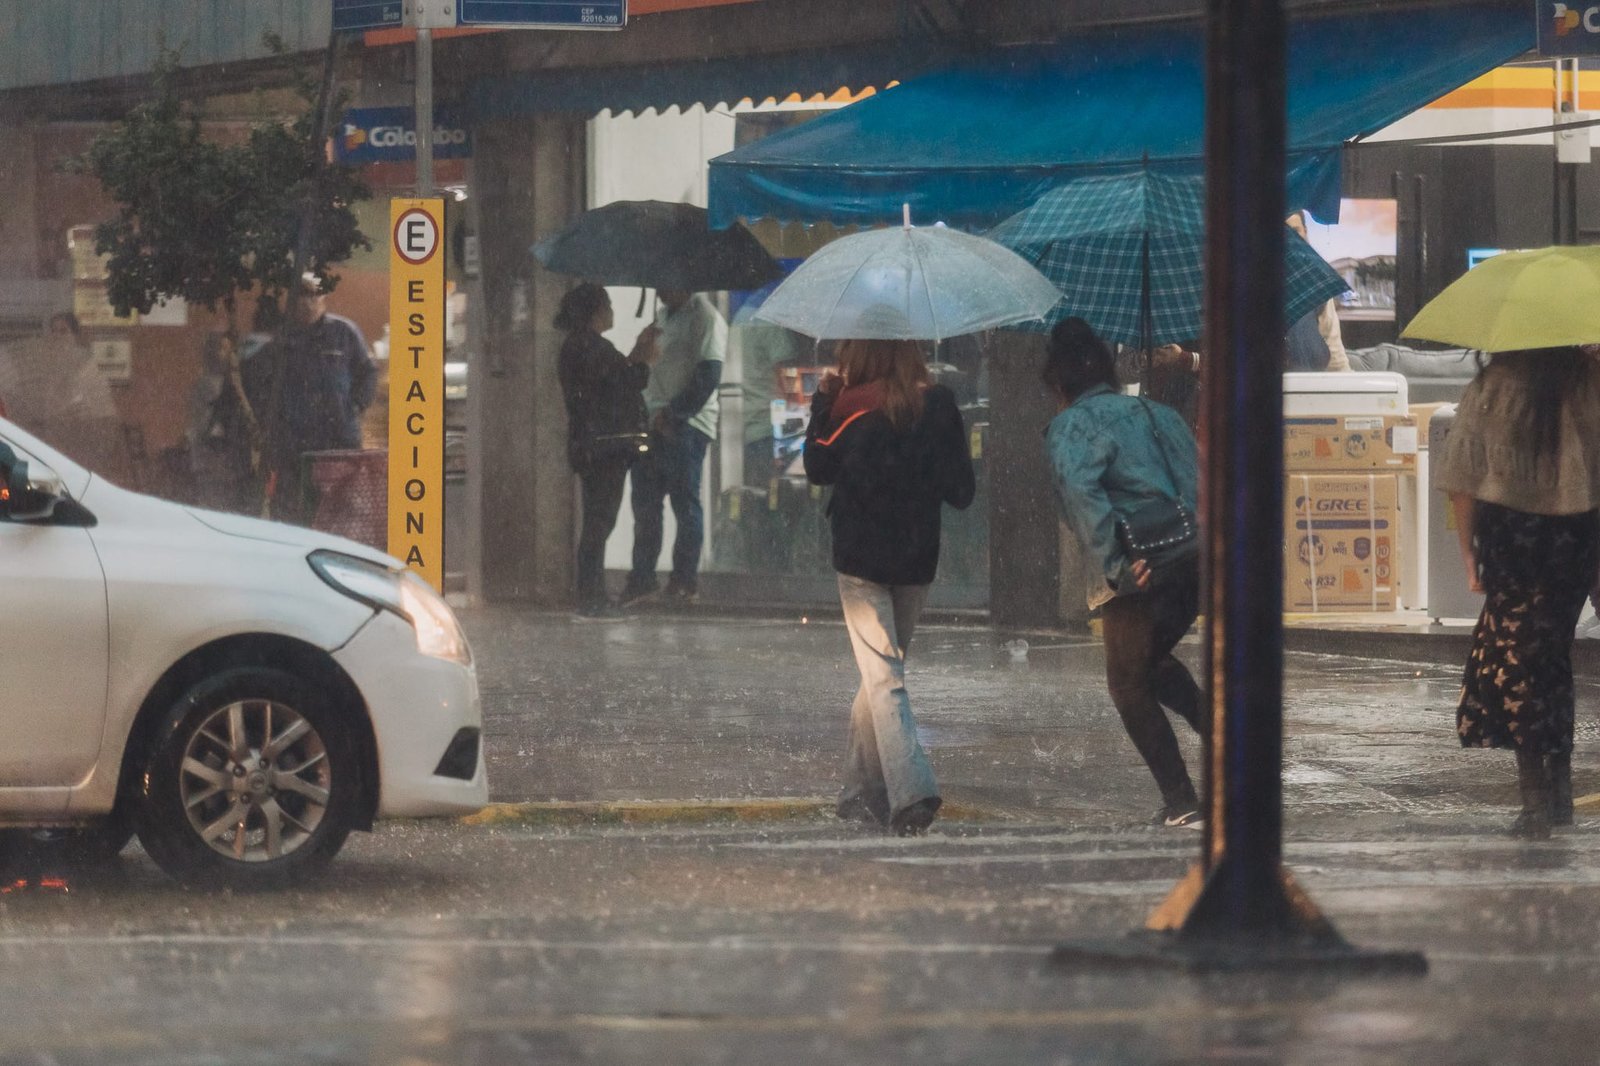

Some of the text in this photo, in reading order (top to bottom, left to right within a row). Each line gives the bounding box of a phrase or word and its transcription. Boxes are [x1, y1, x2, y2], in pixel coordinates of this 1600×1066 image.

[407, 221, 426, 252] E
[405, 280, 426, 568] ESTACIONA
[1316, 499, 1367, 512] GREE
